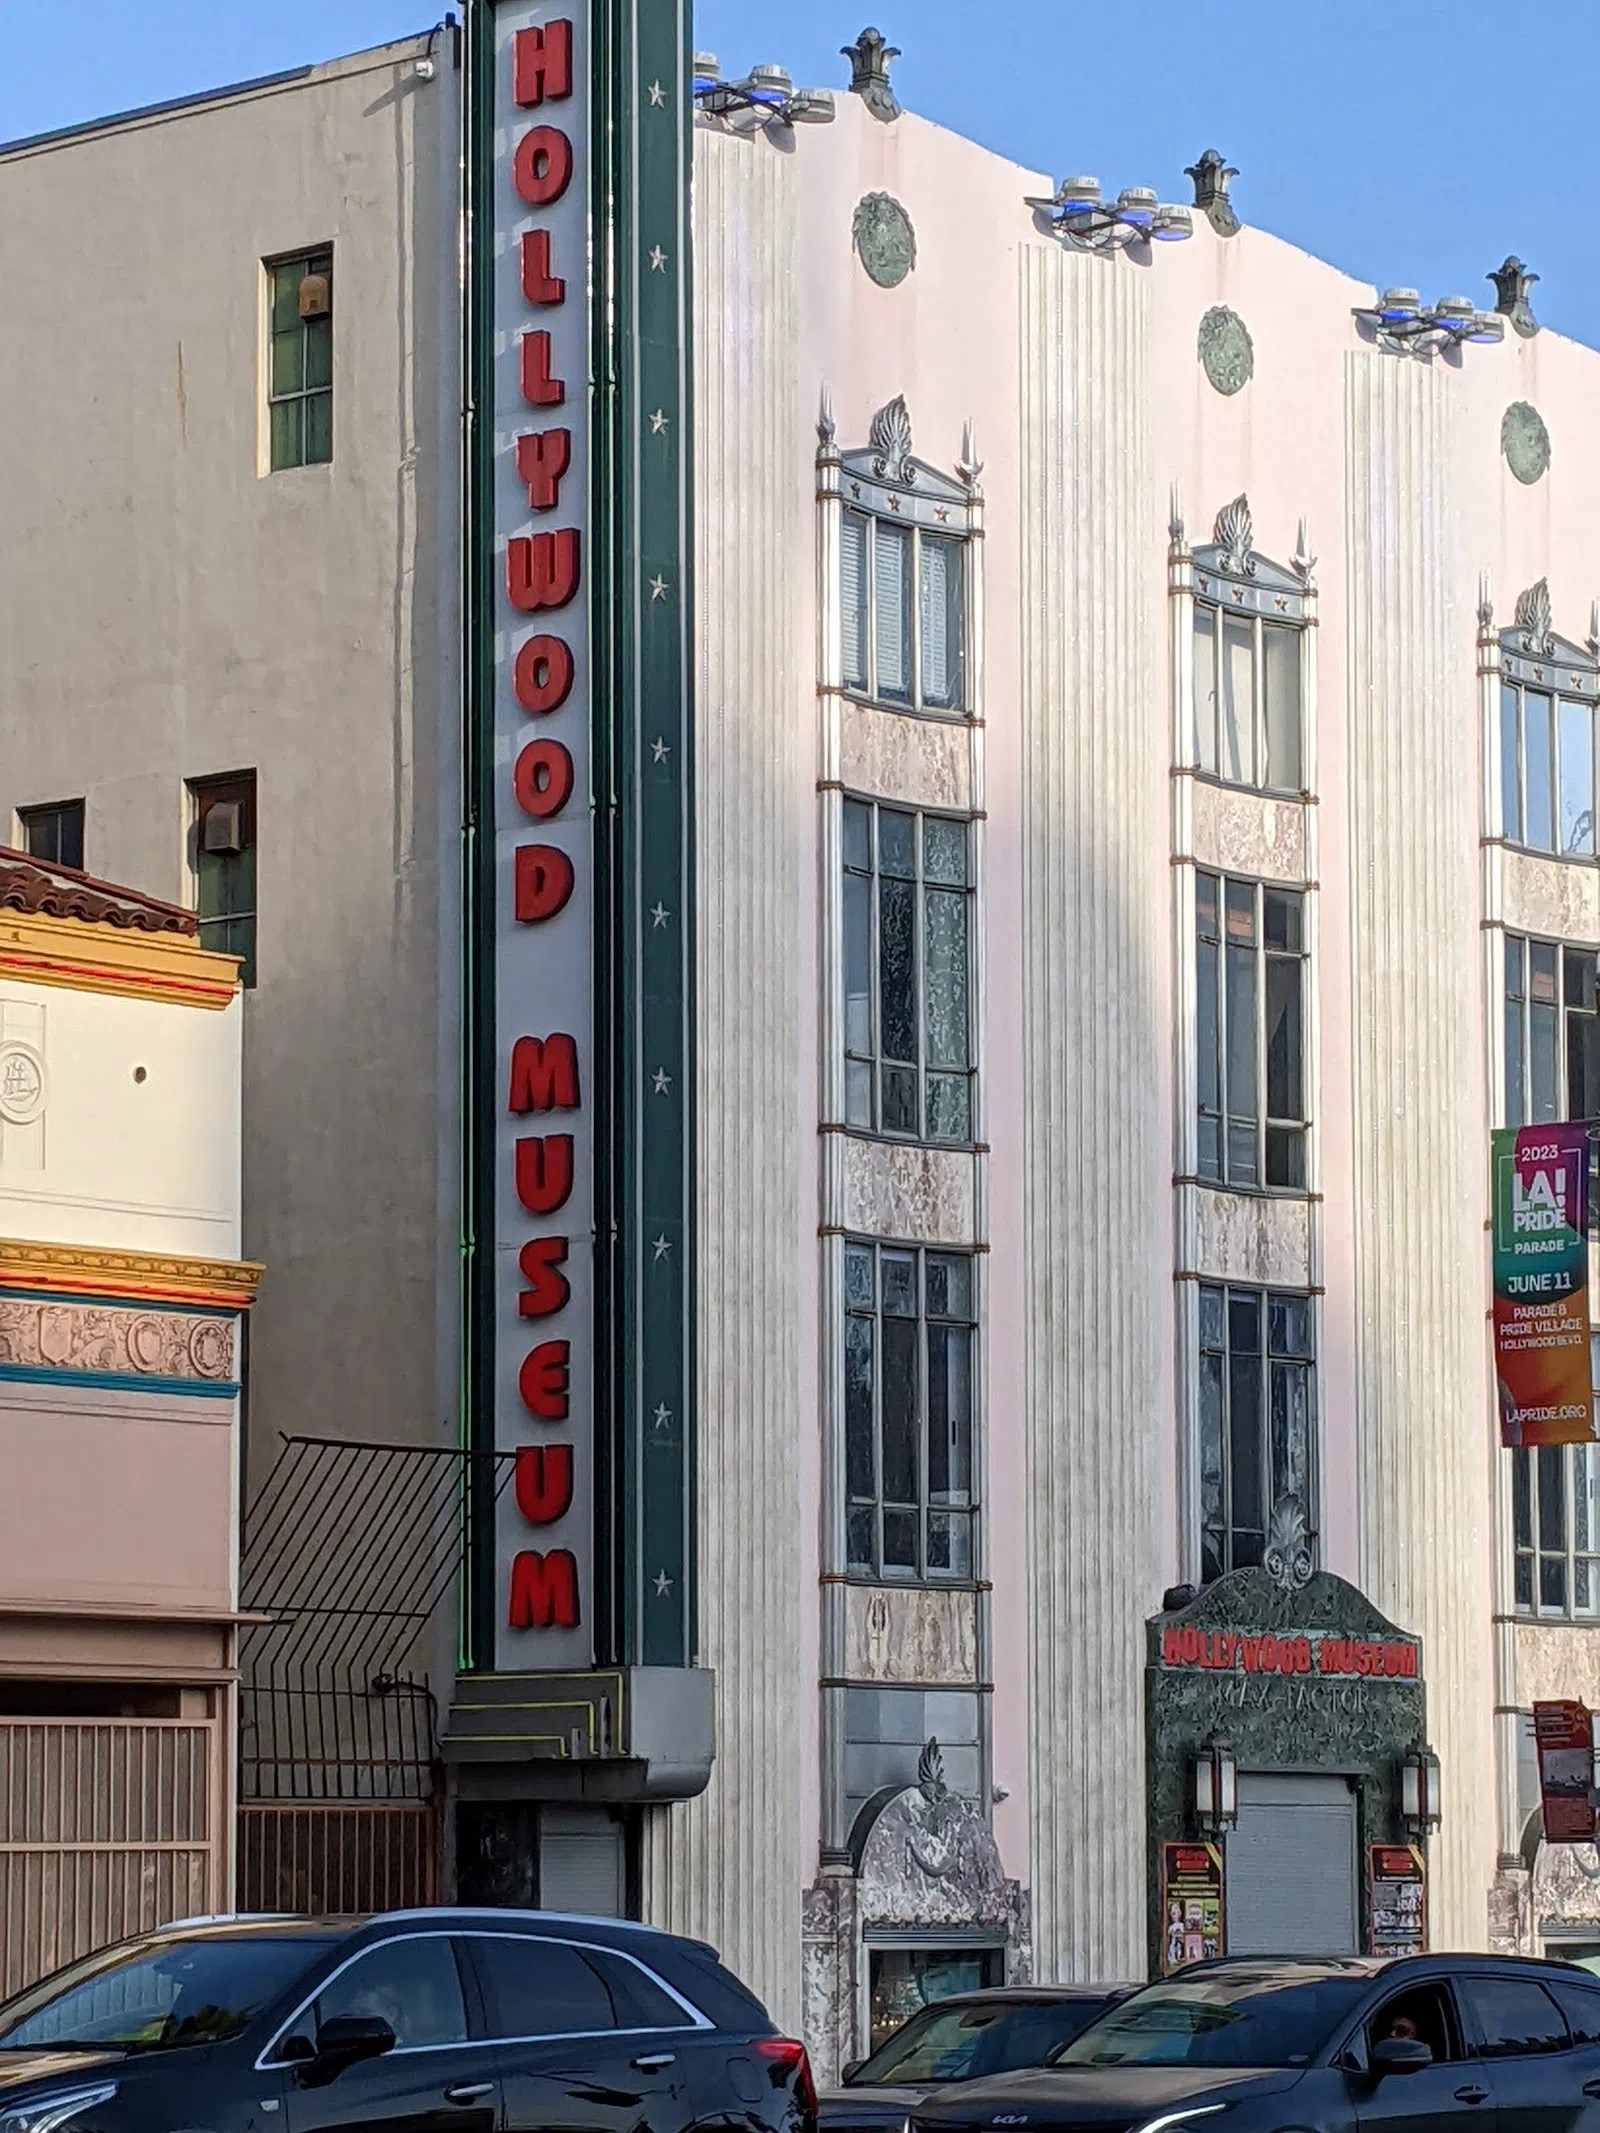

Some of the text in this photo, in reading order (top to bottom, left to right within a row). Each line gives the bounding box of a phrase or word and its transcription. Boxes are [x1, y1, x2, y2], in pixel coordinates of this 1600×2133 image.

[507, 17, 582, 1629] HOLLYWOOD MUSEUM
[1521, 1144, 1559, 1162] 2023
[1512, 1209, 1566, 1233] PRIDE
[1514, 1239, 1565, 1255] PARADE
[1507, 1270, 1573, 1294] JUNE 11
[1513, 1304, 1557, 1320] PARADE
[1500, 1317, 1583, 1336] PRIDE VILLAGE
[1163, 1626, 1419, 1678] HOLLYWOOD MUSEUM
